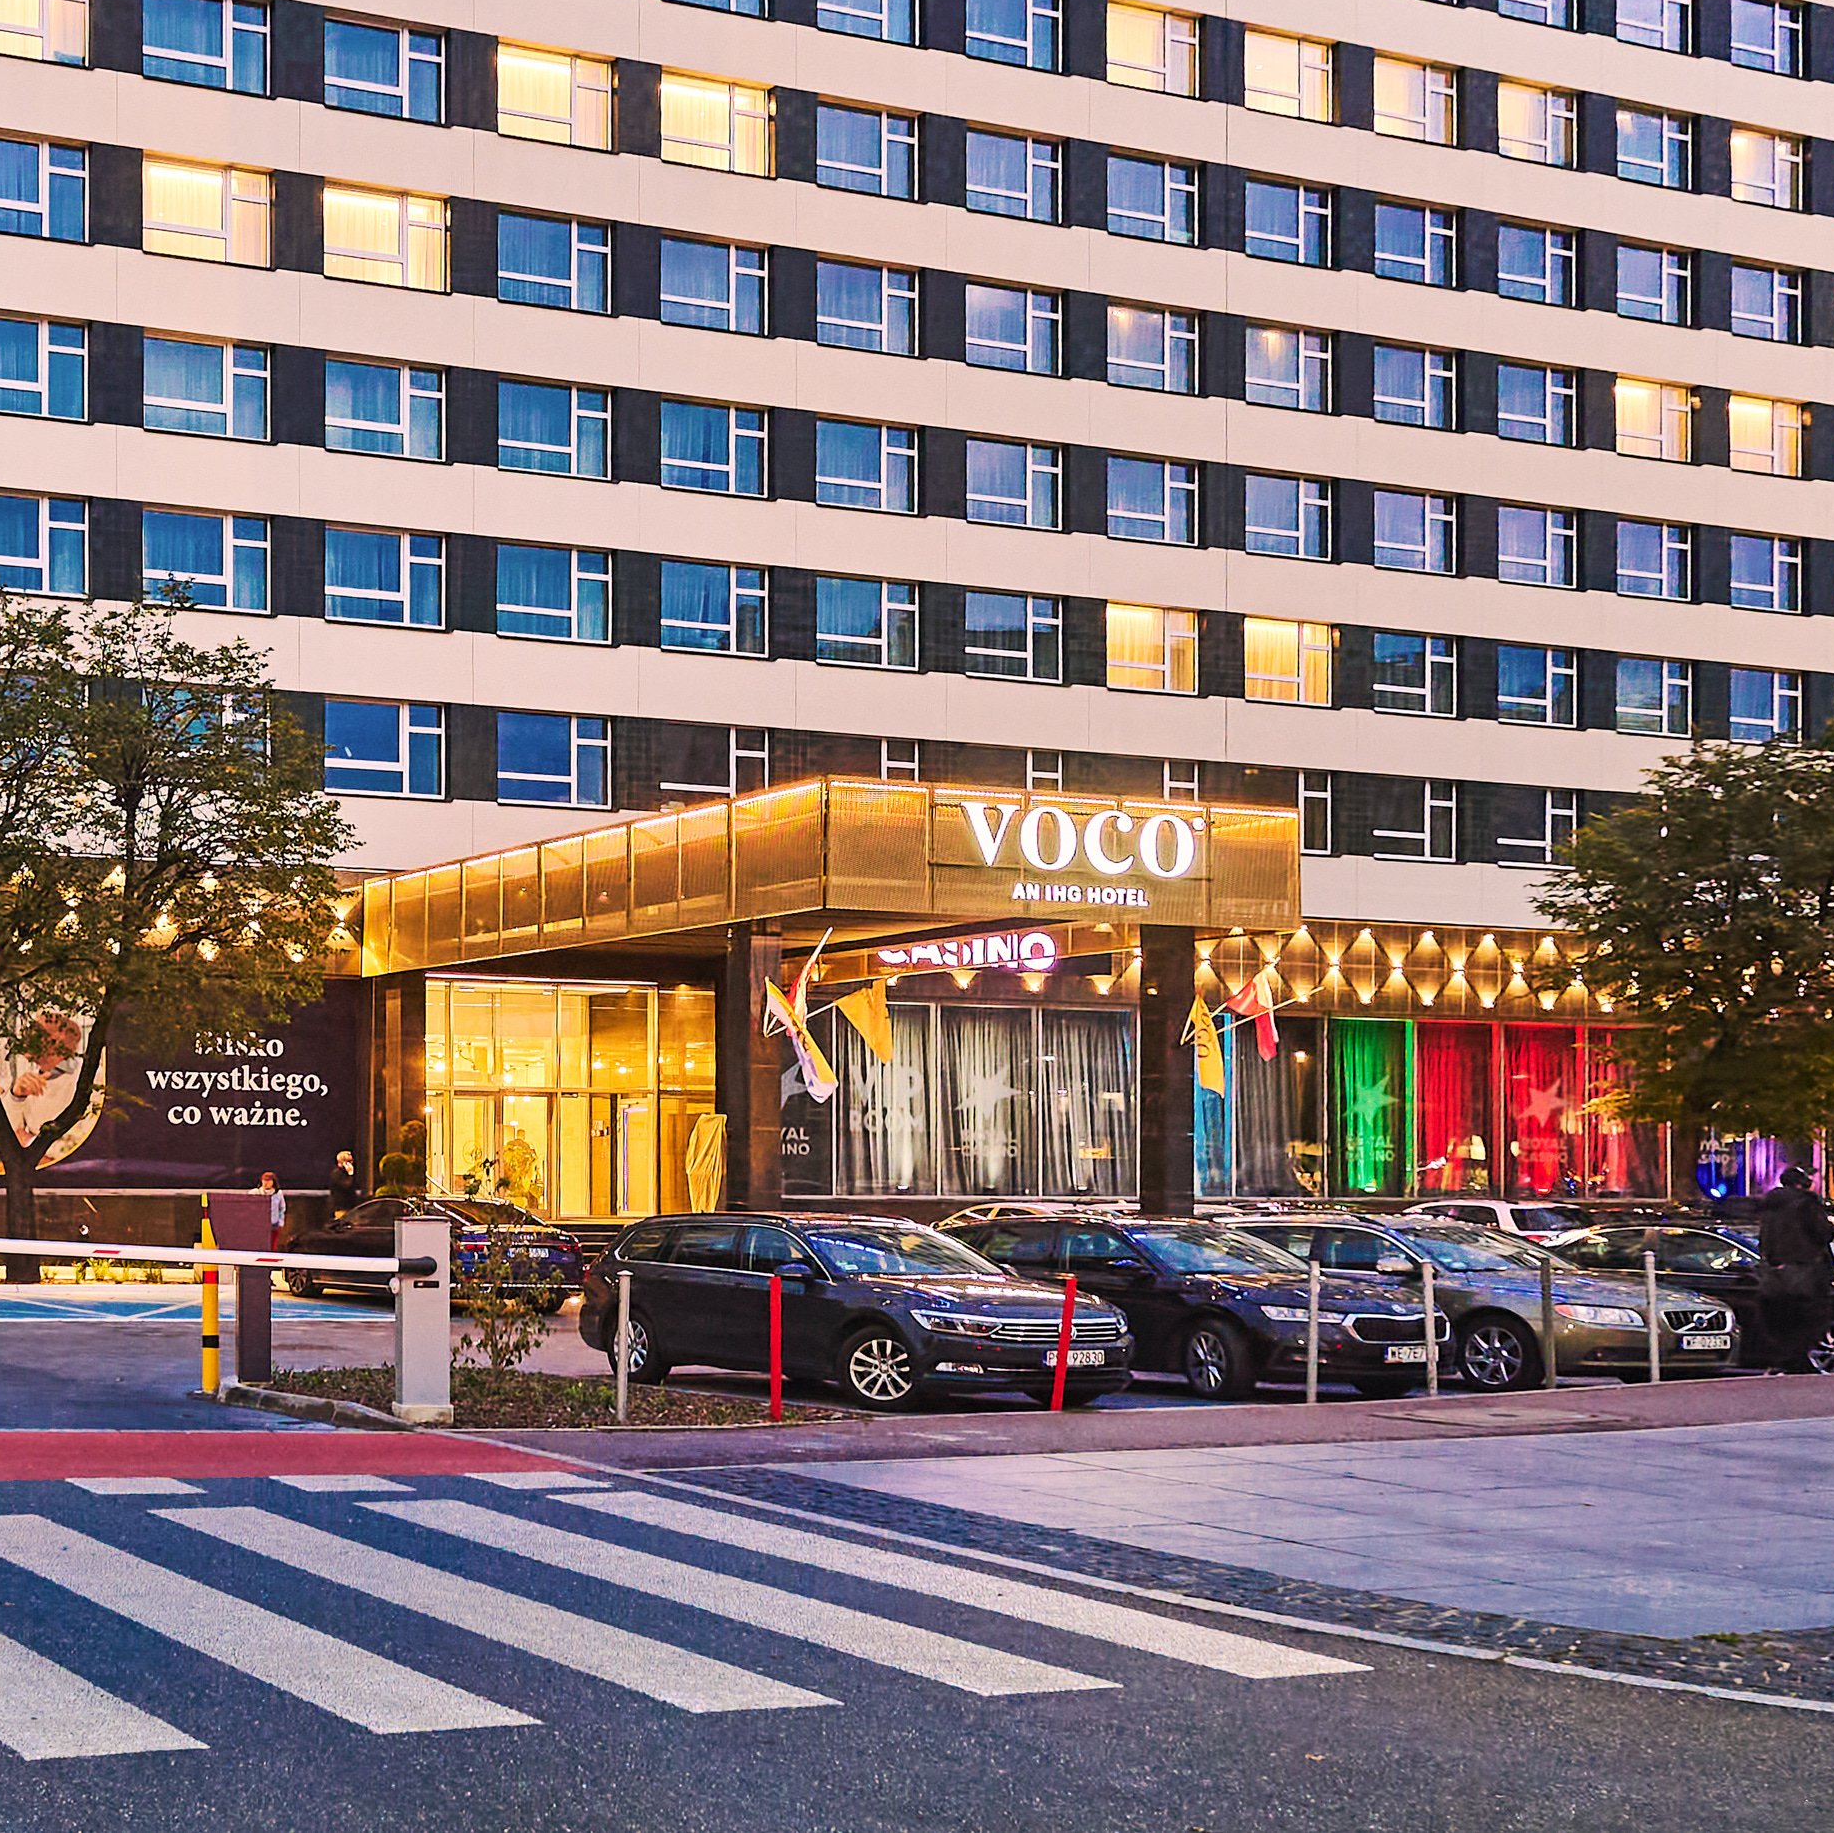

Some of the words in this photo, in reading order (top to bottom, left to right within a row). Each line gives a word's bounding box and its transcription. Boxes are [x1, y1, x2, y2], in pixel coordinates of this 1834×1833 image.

[1012, 882, 1041, 900] AN
[1045, 885, 1082, 903] IHG
[1086, 886, 1150, 907] HOTEL
[146, 1065, 328, 1100] wszystkiego,
[167, 1105, 201, 1125] co
[208, 1100, 308, 1127] ważne.
[1072, 1351, 1104, 1364] 92830
